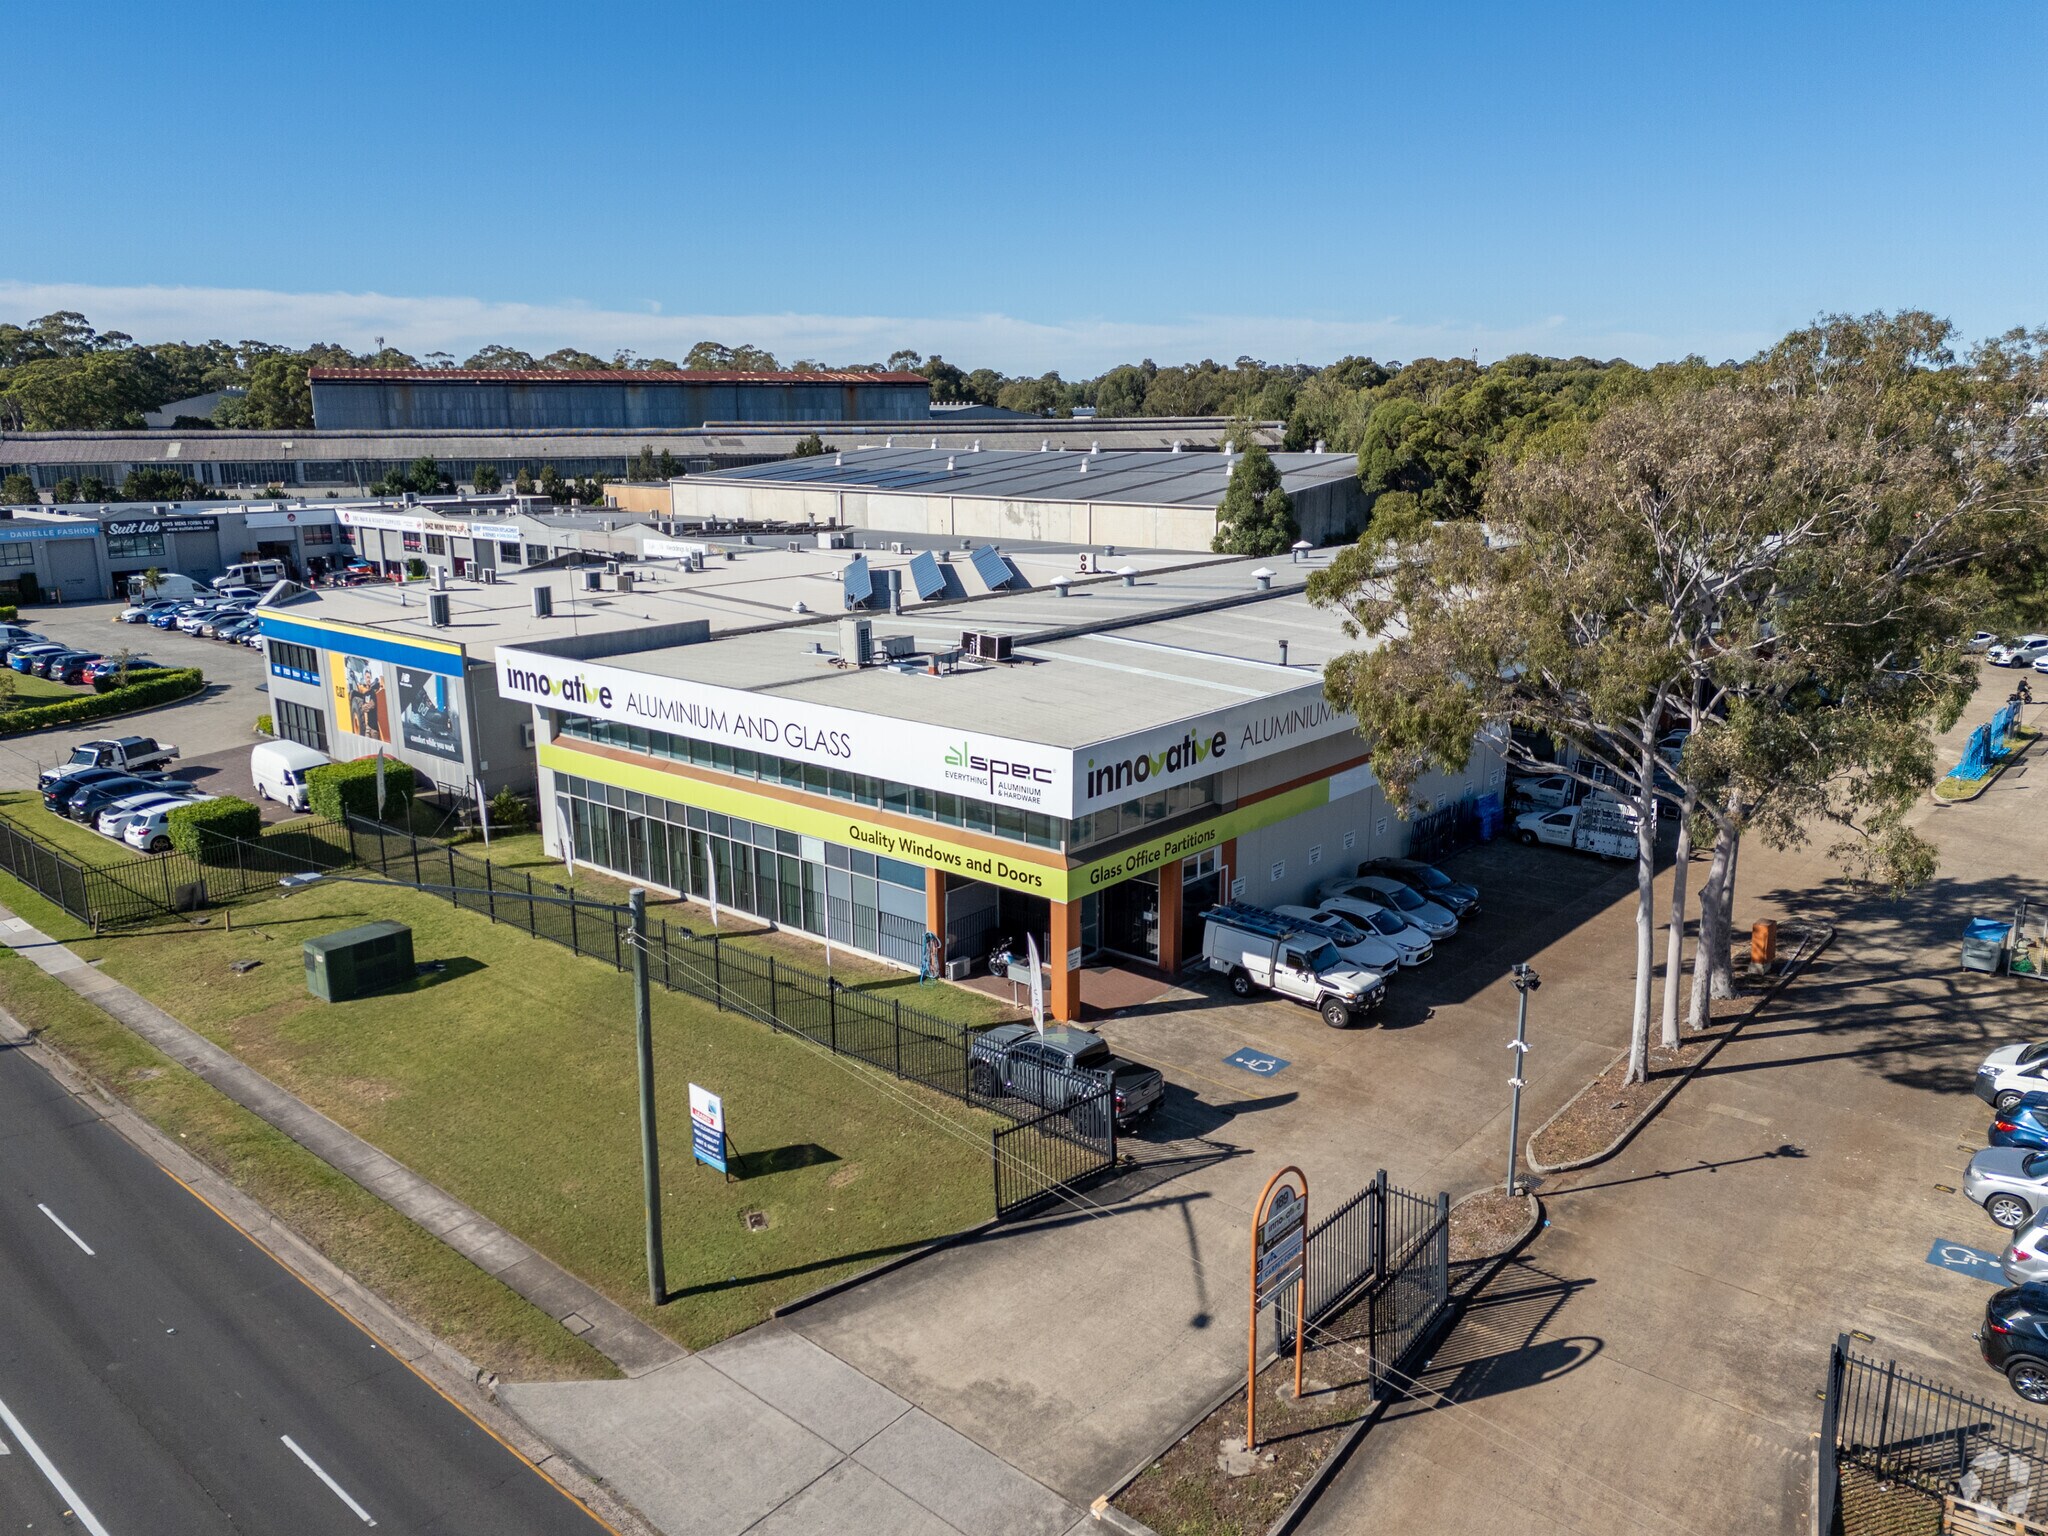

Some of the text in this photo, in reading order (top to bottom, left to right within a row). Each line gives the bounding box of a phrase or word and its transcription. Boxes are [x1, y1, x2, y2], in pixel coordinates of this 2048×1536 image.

[10, 526, 96, 538] DANIELLE FASHION
[108, 521, 160, 535] Suit Lab
[506, 659, 851, 759] innovative ALUMINIUM AND GLASS
[1087, 701, 1334, 799] innovative ALUMINIUM
[944, 741, 1052, 795] alspec
[945, 770, 988, 786] EVERYTHING
[998, 781, 1041, 796] ALUMINIUM
[1003, 791, 1041, 804] HARDWARE
[849, 825, 1042, 887] Quality Windows and Doors
[1089, 829, 1216, 885] Glass Office Partitions
[1274, 1190, 1289, 1210] 189
[1264, 1259, 1284, 1277] CARPET
